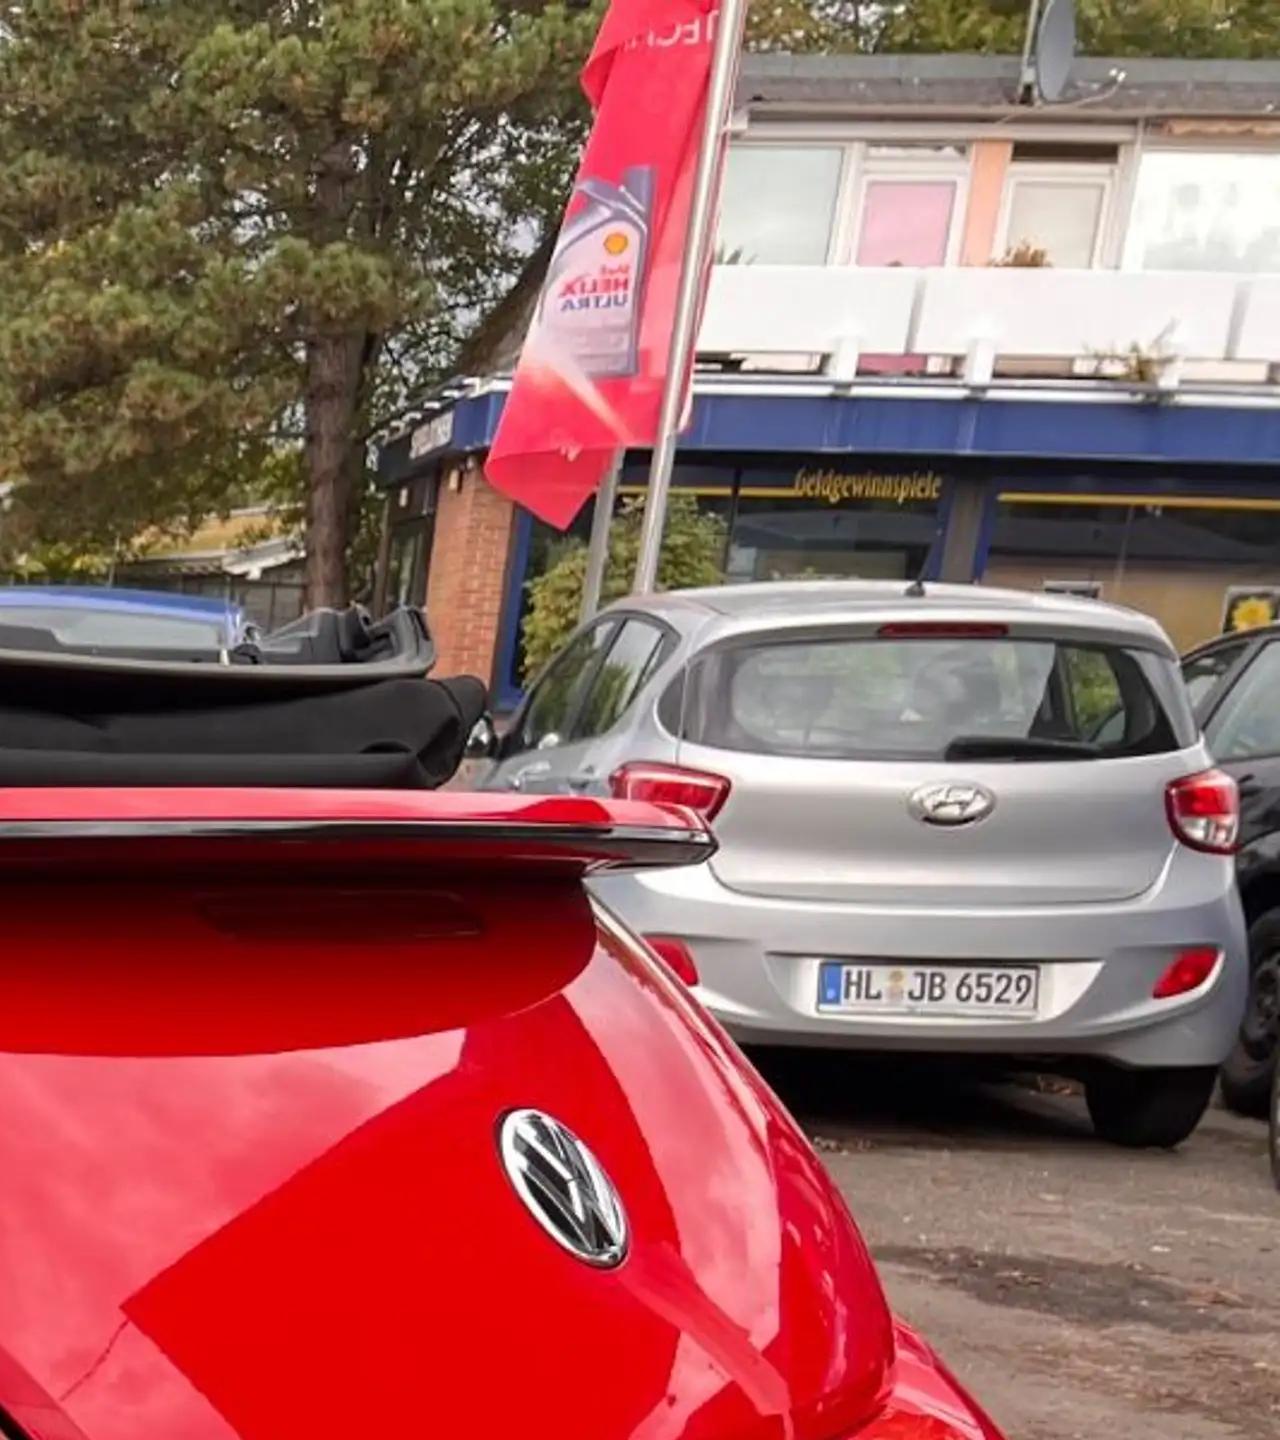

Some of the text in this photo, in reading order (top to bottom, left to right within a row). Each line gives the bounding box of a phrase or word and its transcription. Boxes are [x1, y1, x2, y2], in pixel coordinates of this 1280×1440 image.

[795, 467, 942, 505] Geldgewinnspiele
[843, 970, 1032, 1005] HL JB 6529
